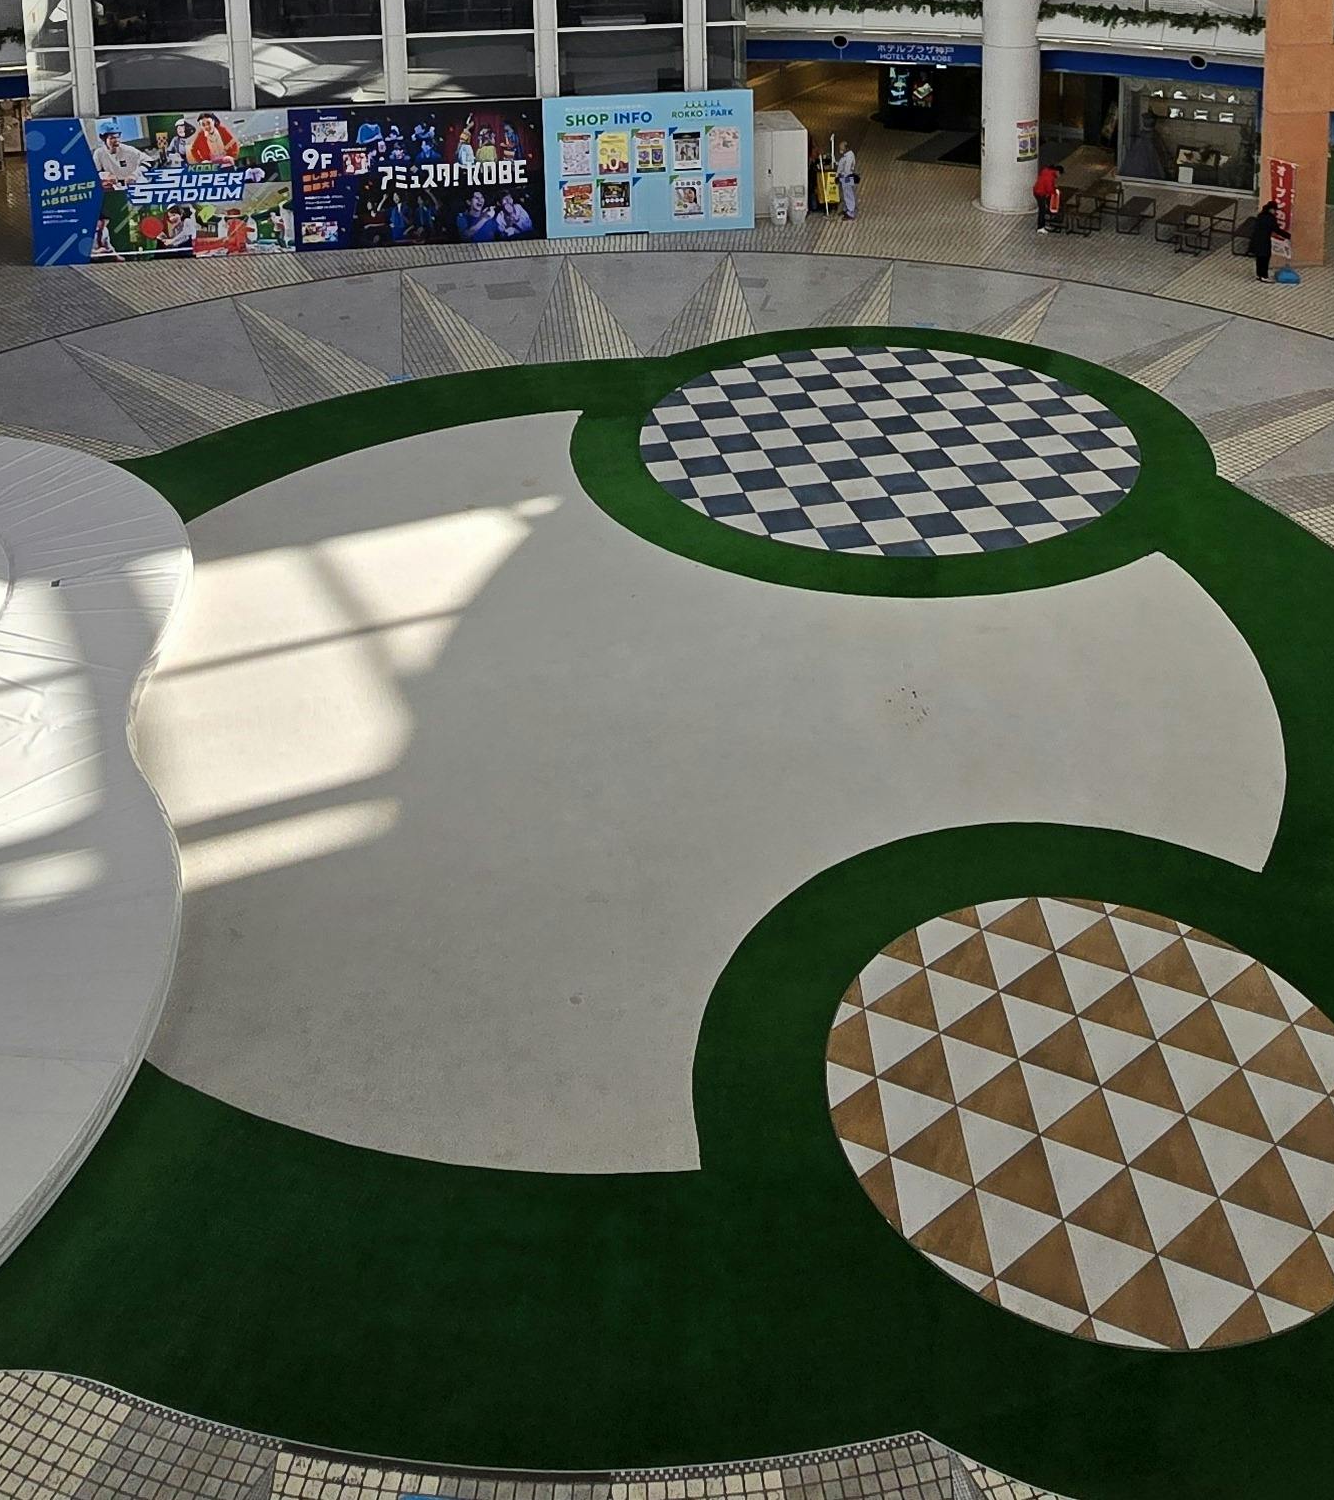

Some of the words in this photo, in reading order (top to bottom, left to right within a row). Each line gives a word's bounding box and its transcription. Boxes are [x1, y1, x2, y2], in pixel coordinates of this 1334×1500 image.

[879, 53, 905, 61] HOTEL
[565, 113, 609, 127] SHOP
[614, 111, 652, 125] INFO
[671, 111, 703, 119] ROKKO
[710, 108, 733, 117] PARK
[188, 163, 219, 172] KOBE
[302, 149, 332, 170] 9F
[43, 160, 76, 182] 8F
[141, 168, 244, 189] SUPER
[377, 161, 460, 191] アミュスタ!
[467, 159, 528, 187] KOBE
[130, 185, 242, 204] STADIUM
[1275, 165, 1287, 230] オープンカフ
